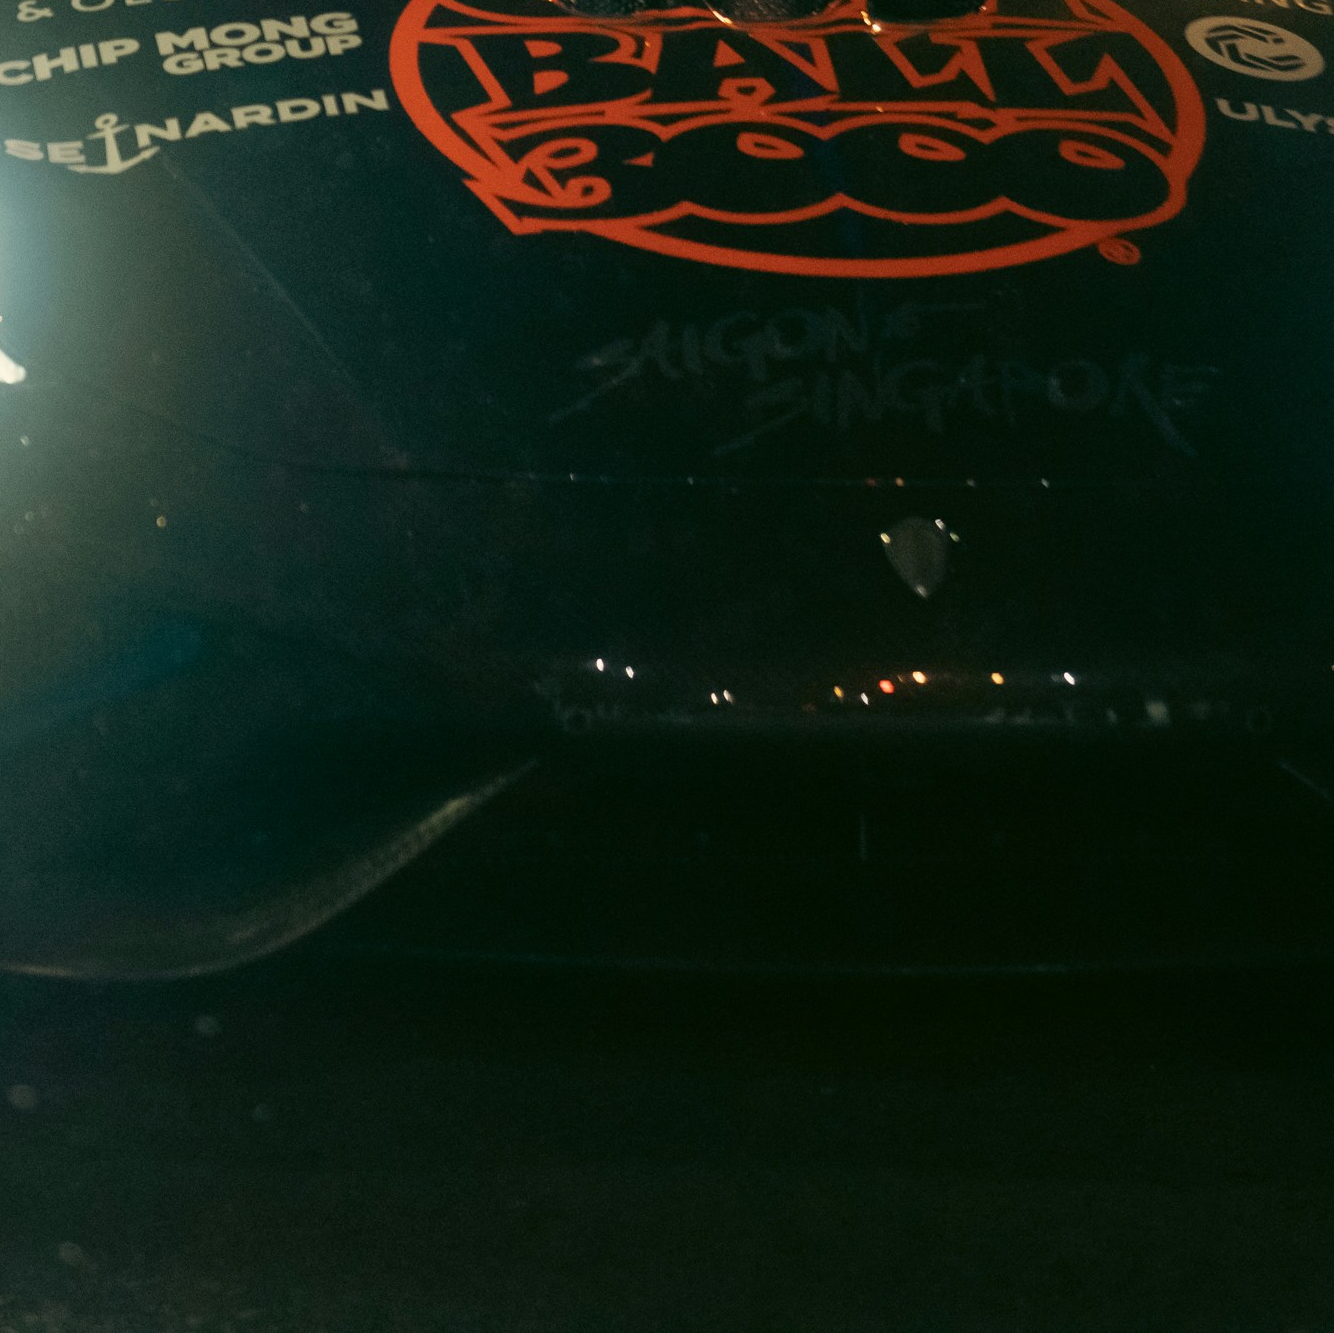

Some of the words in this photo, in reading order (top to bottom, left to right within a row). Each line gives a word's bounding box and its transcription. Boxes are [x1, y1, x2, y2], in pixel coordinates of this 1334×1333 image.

[16, 0, 55, 22] &
[154, 12, 359, 56] MONG
[162, 33, 363, 76] GROUP
[134, 88, 390, 148] NARDIN
[712, 352, 1220, 458] SINGAPORE
